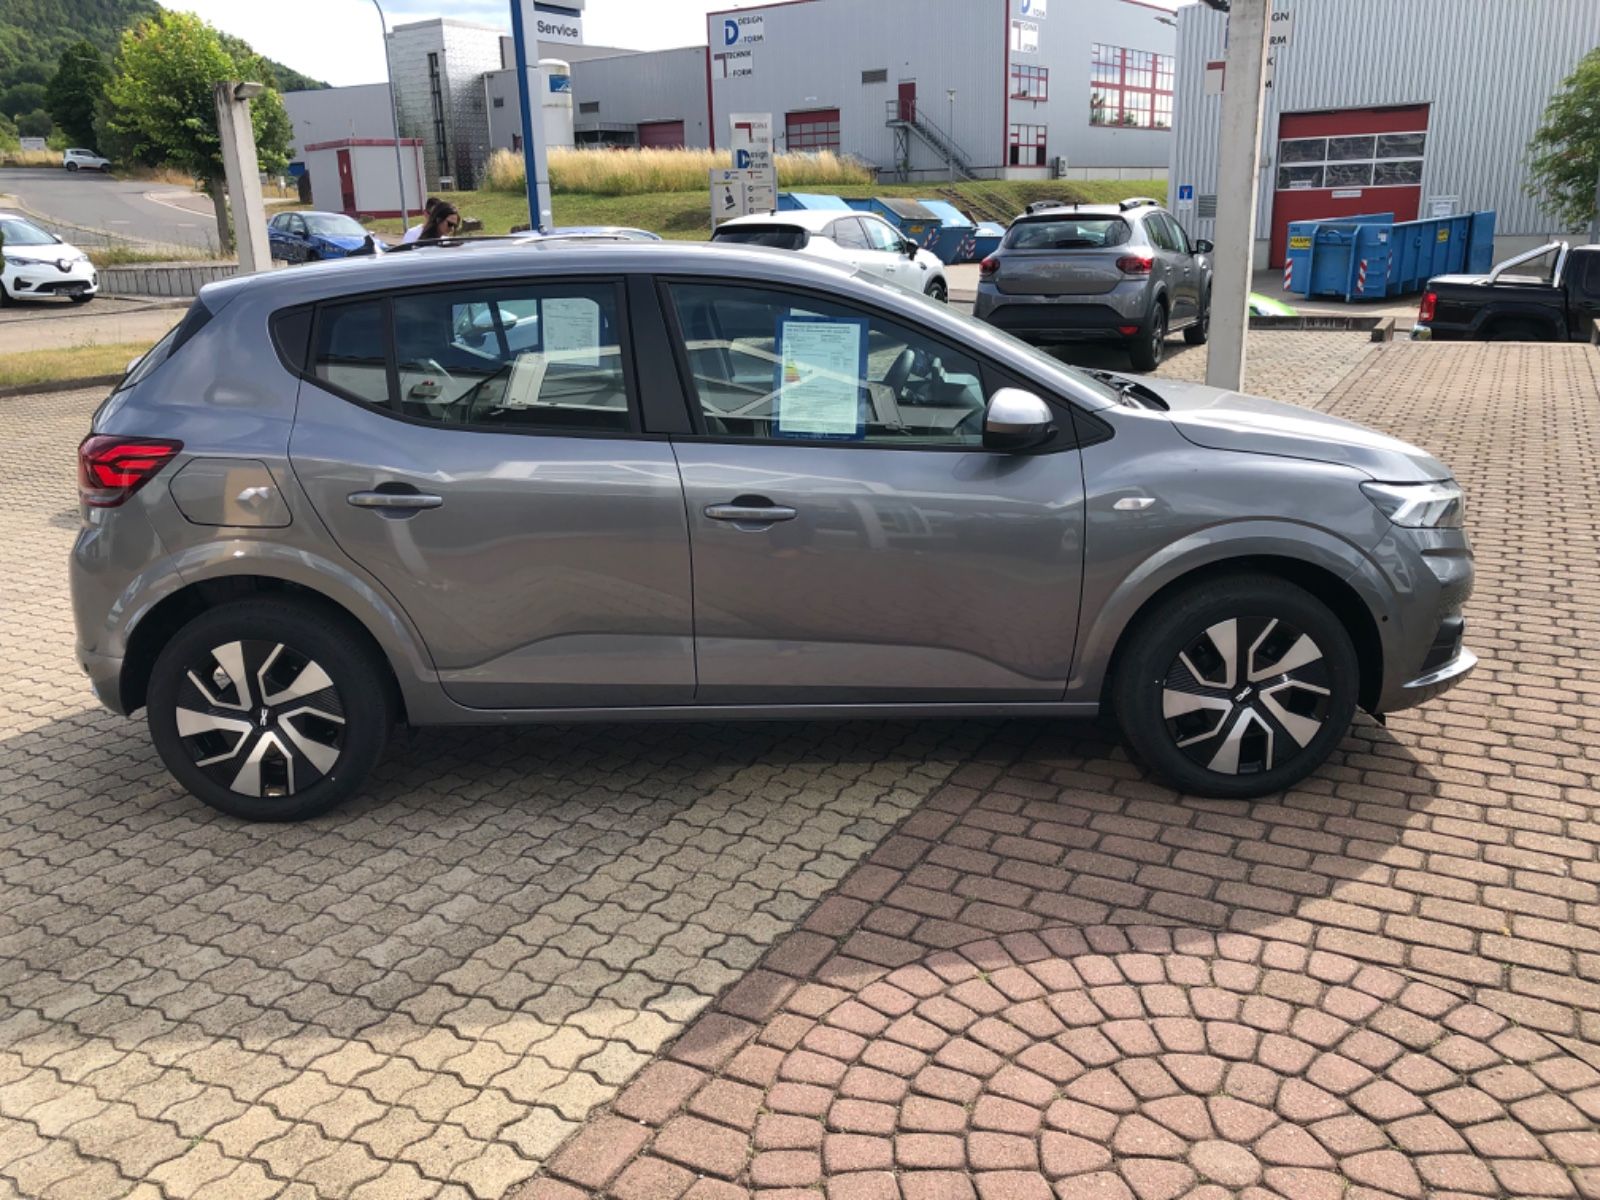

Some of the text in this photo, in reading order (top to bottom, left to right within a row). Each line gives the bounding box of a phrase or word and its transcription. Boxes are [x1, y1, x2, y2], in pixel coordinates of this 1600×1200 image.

[737, 15, 763, 26] DESIGN
[537, 20, 578, 37] Service
[743, 34, 764, 43] FORM
[726, 50, 752, 60] TECHNIK
[732, 68, 752, 77] FORM
